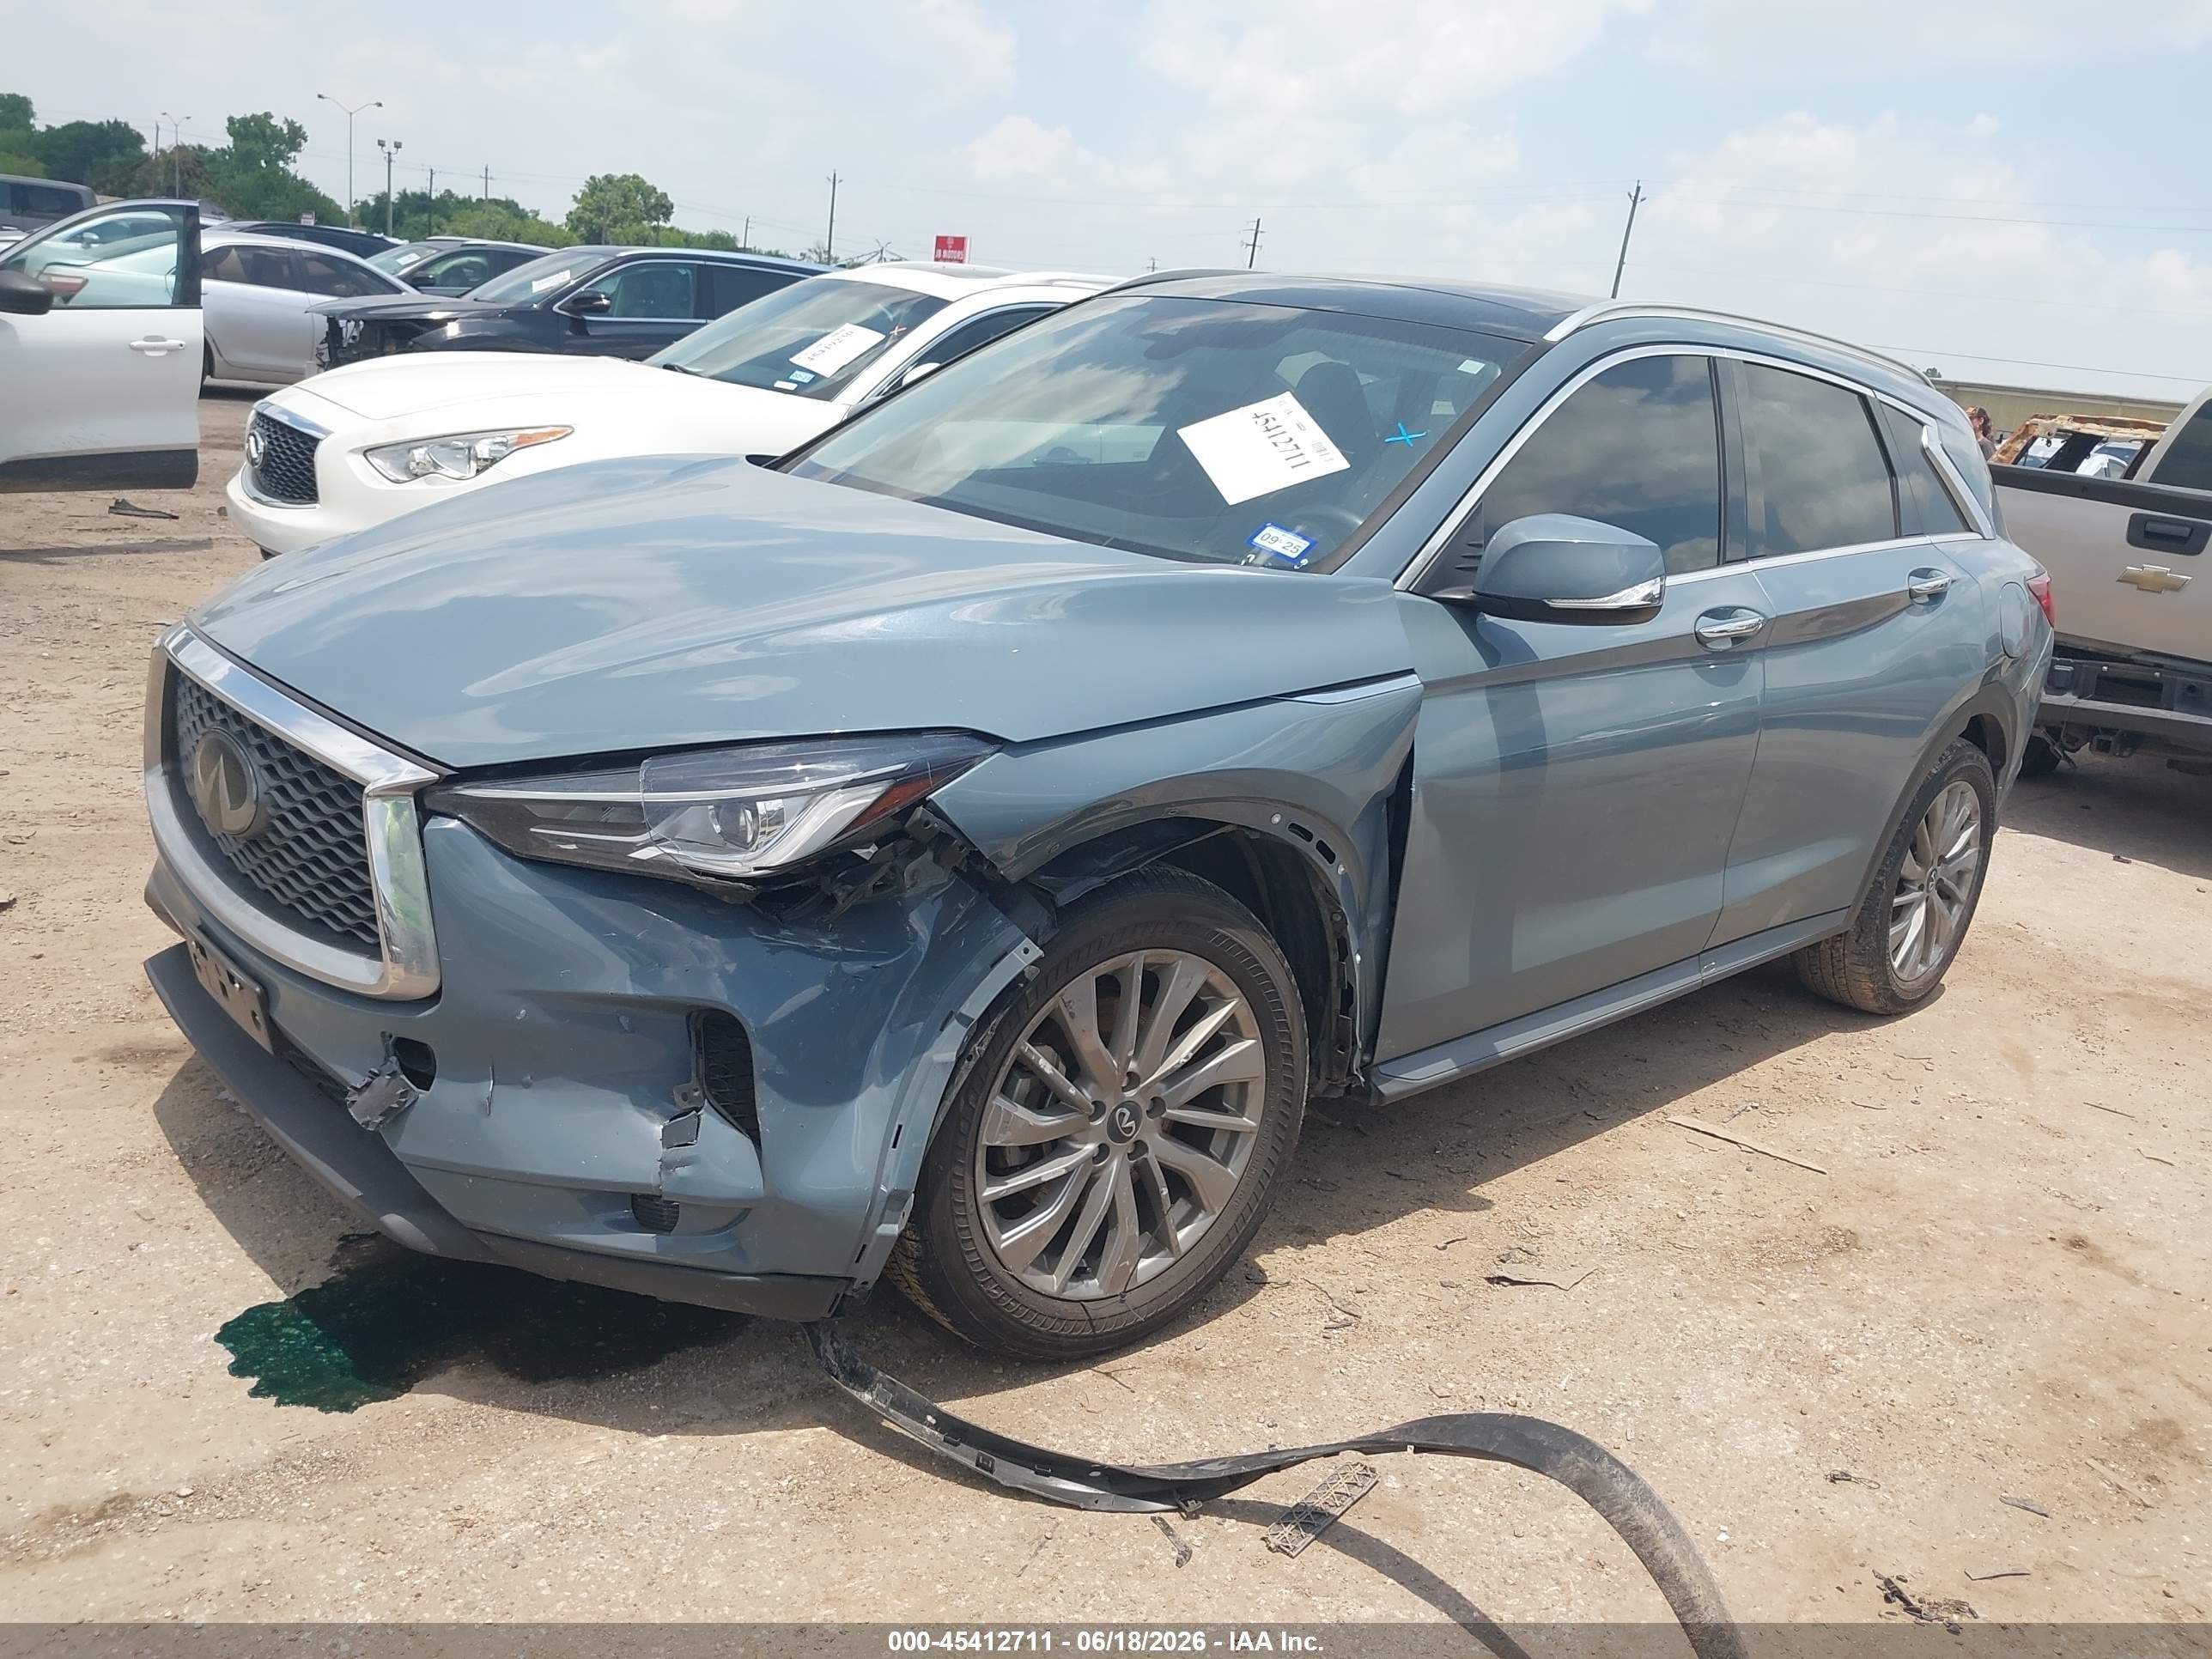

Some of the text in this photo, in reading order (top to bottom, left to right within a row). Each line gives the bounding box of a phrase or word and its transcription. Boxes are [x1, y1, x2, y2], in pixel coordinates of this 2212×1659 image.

[1252, 412, 1311, 469] 45412711
[1260, 532, 1279, 544] 09
[1282, 542, 1302, 554] 25
